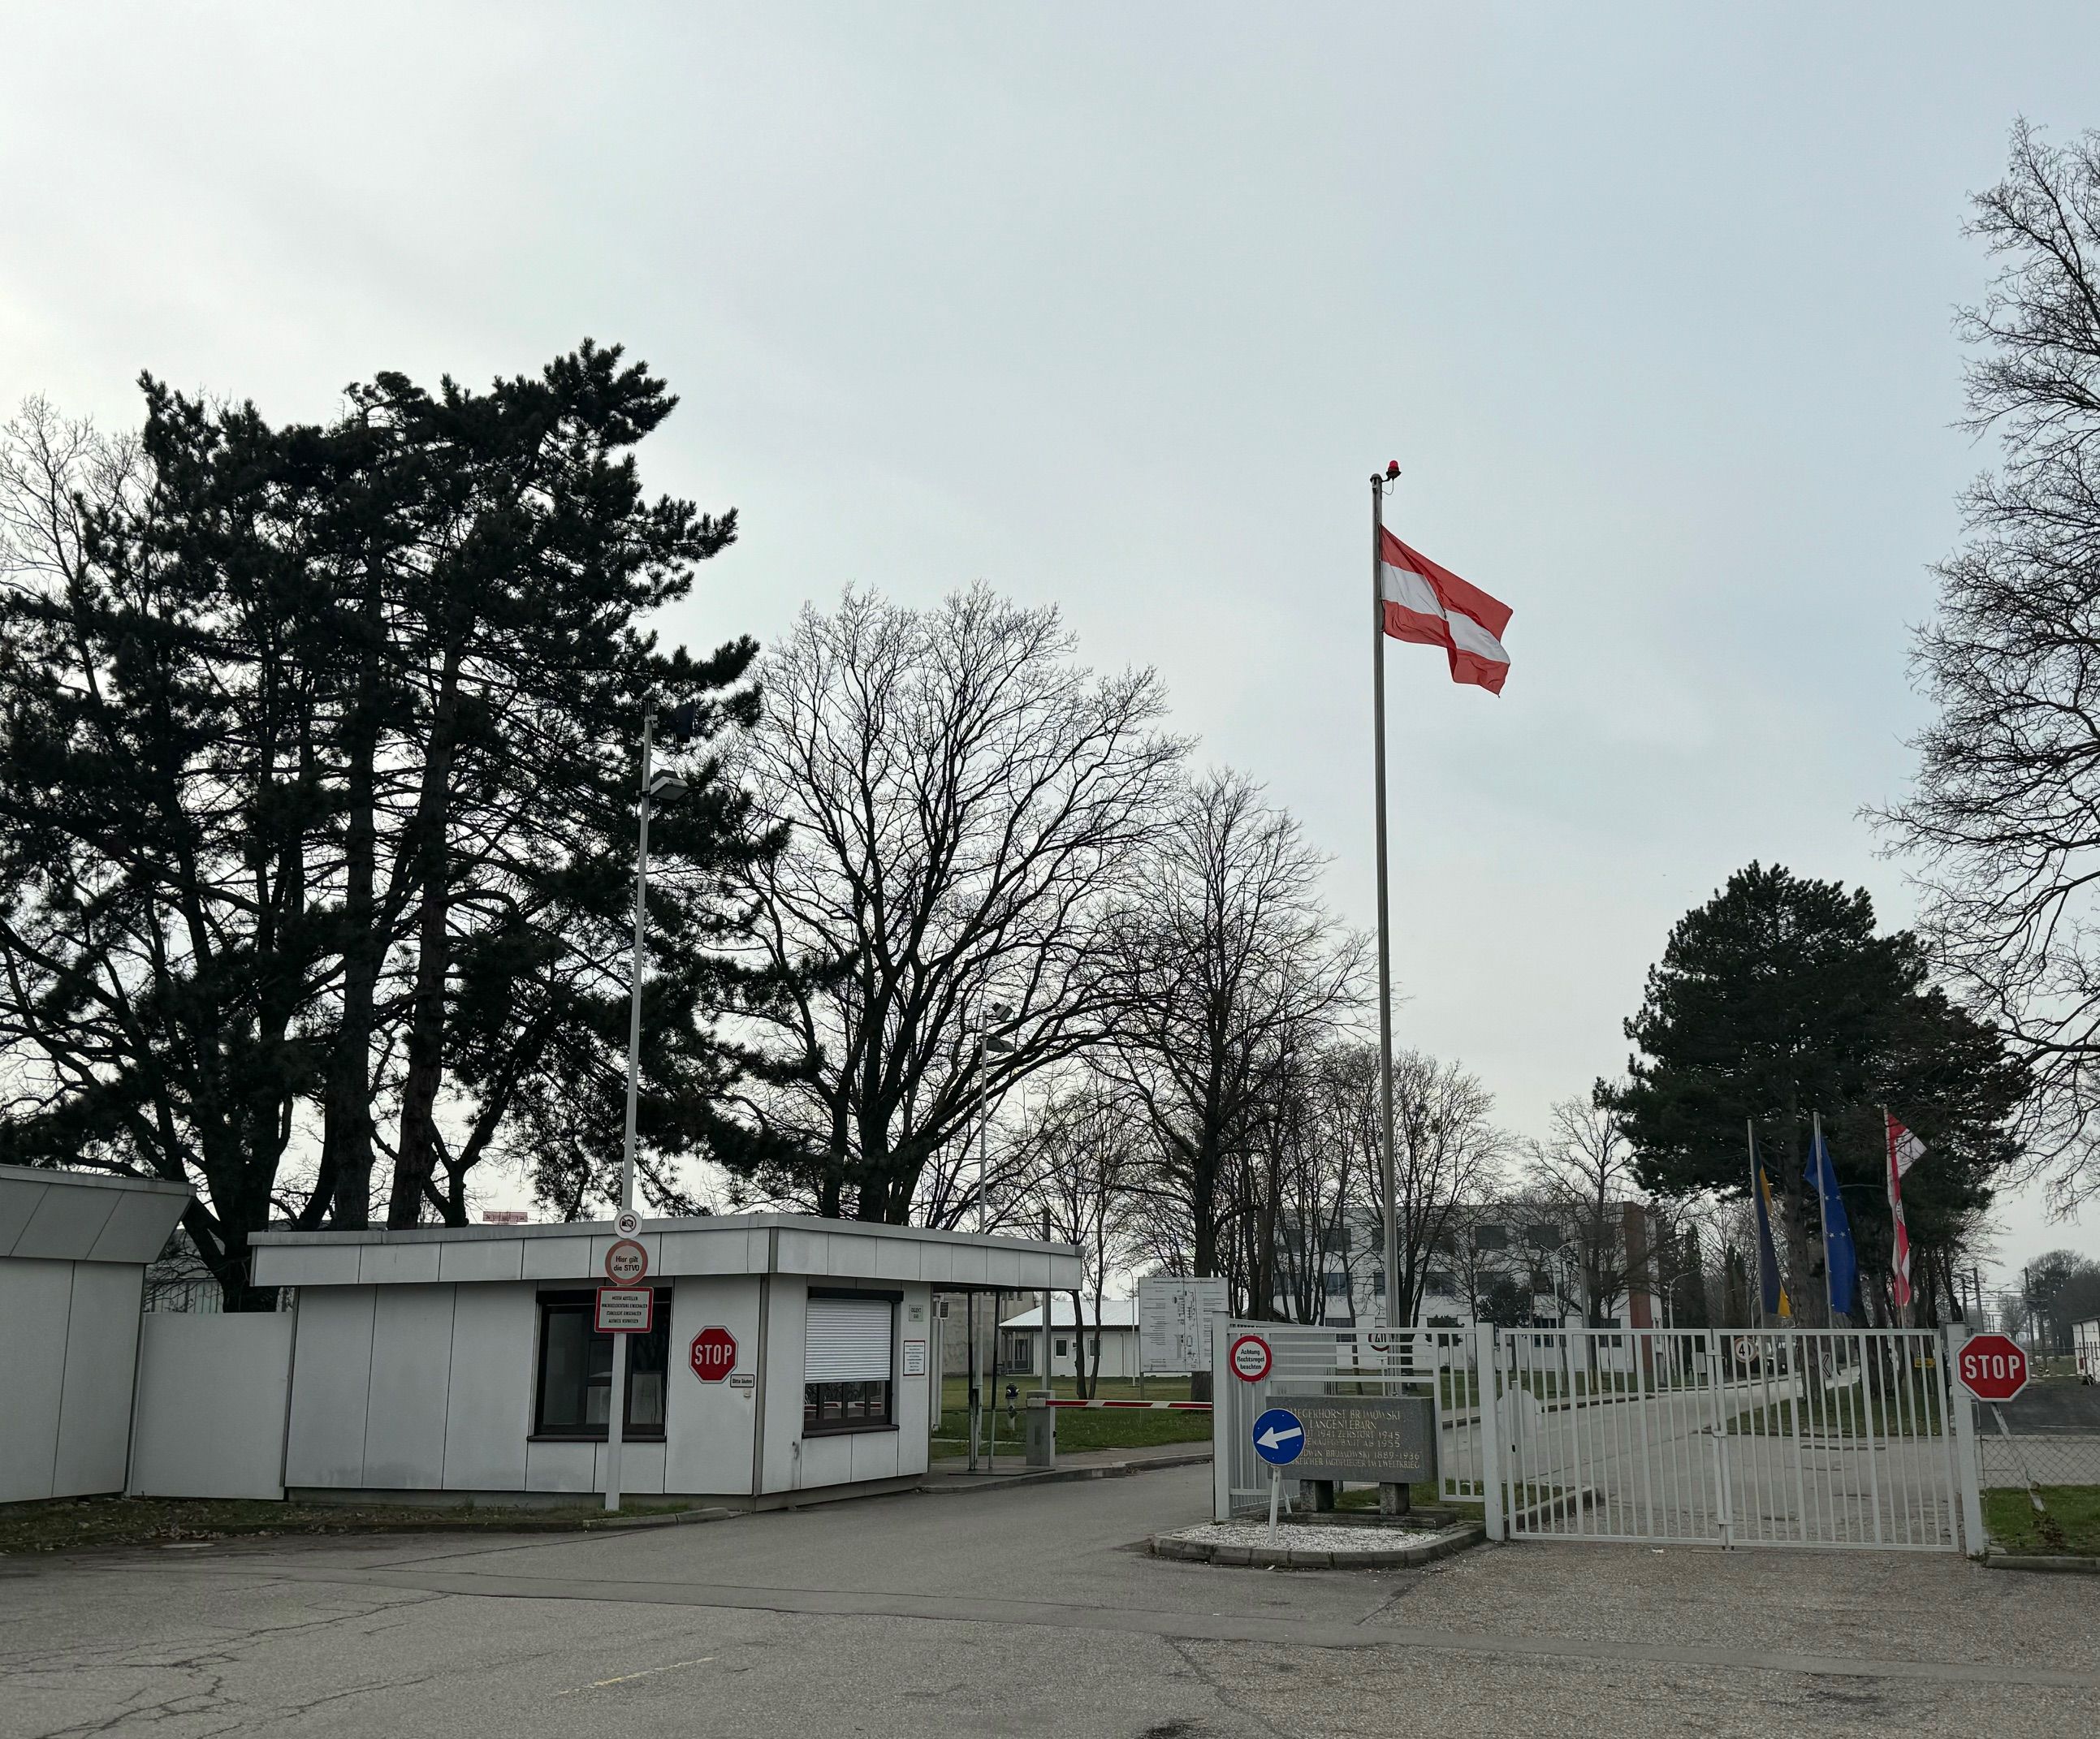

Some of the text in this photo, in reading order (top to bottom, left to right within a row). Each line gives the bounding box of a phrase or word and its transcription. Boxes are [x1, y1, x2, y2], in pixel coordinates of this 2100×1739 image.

[629, 1255, 638, 1264] gilt
[694, 1344, 732, 1365] STOP
[1965, 1355, 2020, 1379] STOP
[1377, 1439, 1401, 1448] 1955
